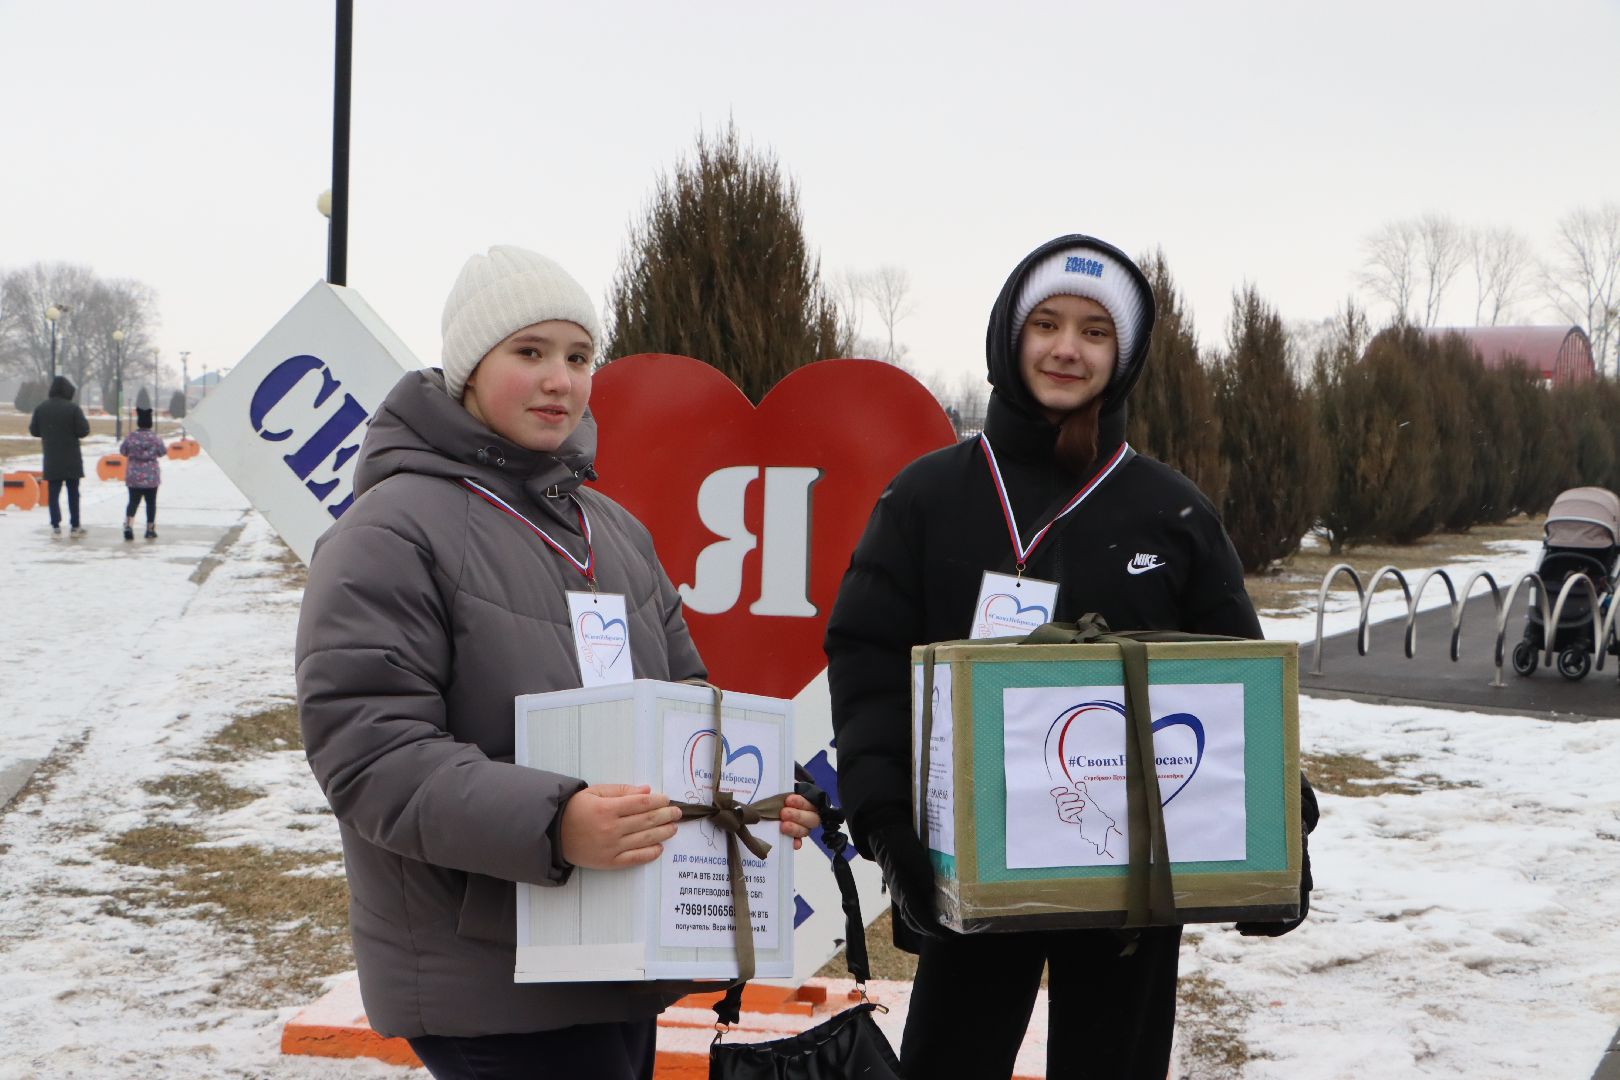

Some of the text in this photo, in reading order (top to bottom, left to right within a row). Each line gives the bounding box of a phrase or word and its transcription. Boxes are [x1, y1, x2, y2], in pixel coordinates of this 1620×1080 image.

[250, 355, 372, 520] СЕ
[678, 465, 820, 617] Я
[1133, 552, 1158, 566] NIKE
[673, 854, 687, 863] ДЛЯ
[689, 856, 729, 866] ФИНАНСОВ
[678, 871, 698, 880] КАРТА
[699, 872, 711, 880] ВТБ
[679, 887, 692, 896] ДЛЯ
[693, 887, 730, 898] ПЕРЕВОДОВ
[674, 902, 736, 918] +7969150656
[757, 911, 769, 919] ВТБ
[712, 923, 727, 932] Вера
